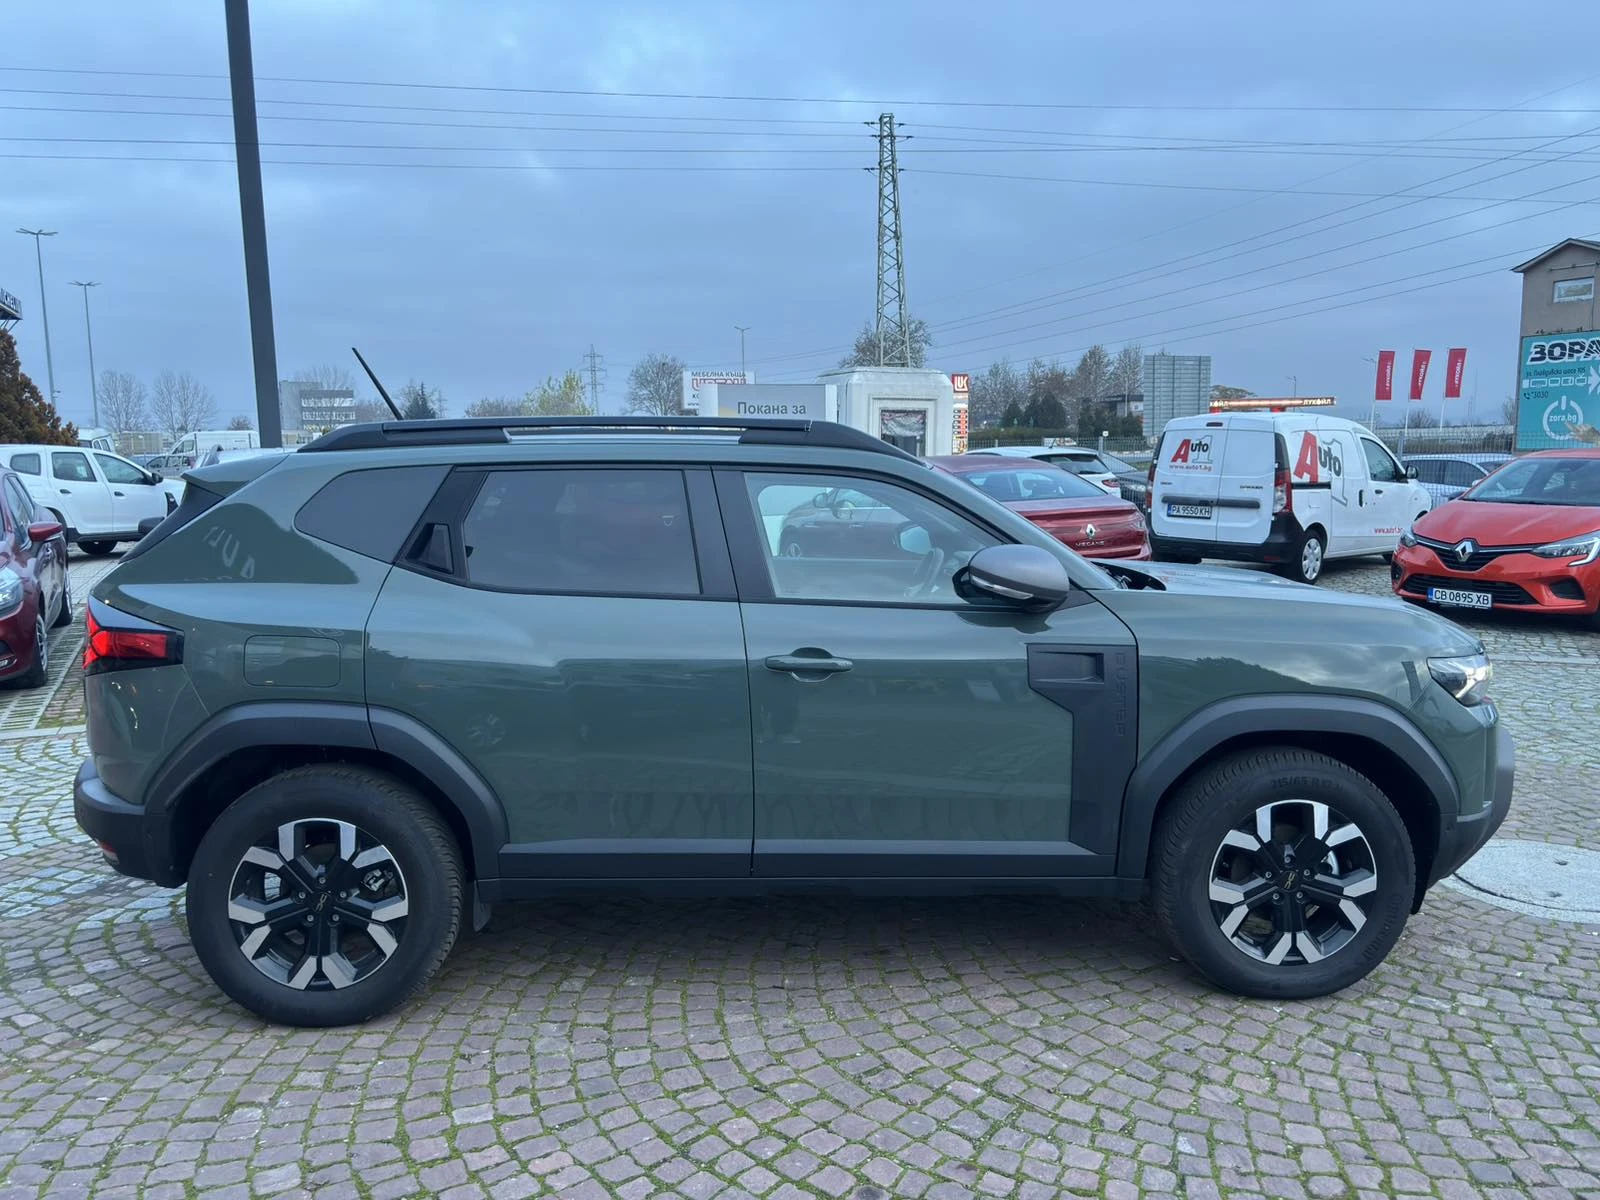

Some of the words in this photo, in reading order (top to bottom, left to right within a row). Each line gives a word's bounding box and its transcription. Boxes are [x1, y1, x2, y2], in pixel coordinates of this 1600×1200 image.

[1527, 338, 1600, 364] ЗОРА
[737, 402, 788, 415] Покана
[792, 405, 806, 415] за
[1549, 413, 1577, 423] zora.bg
[1434, 589, 1447, 601] CB
[1449, 591, 1474, 603] 0895
[1476, 593, 1490, 605] XB
